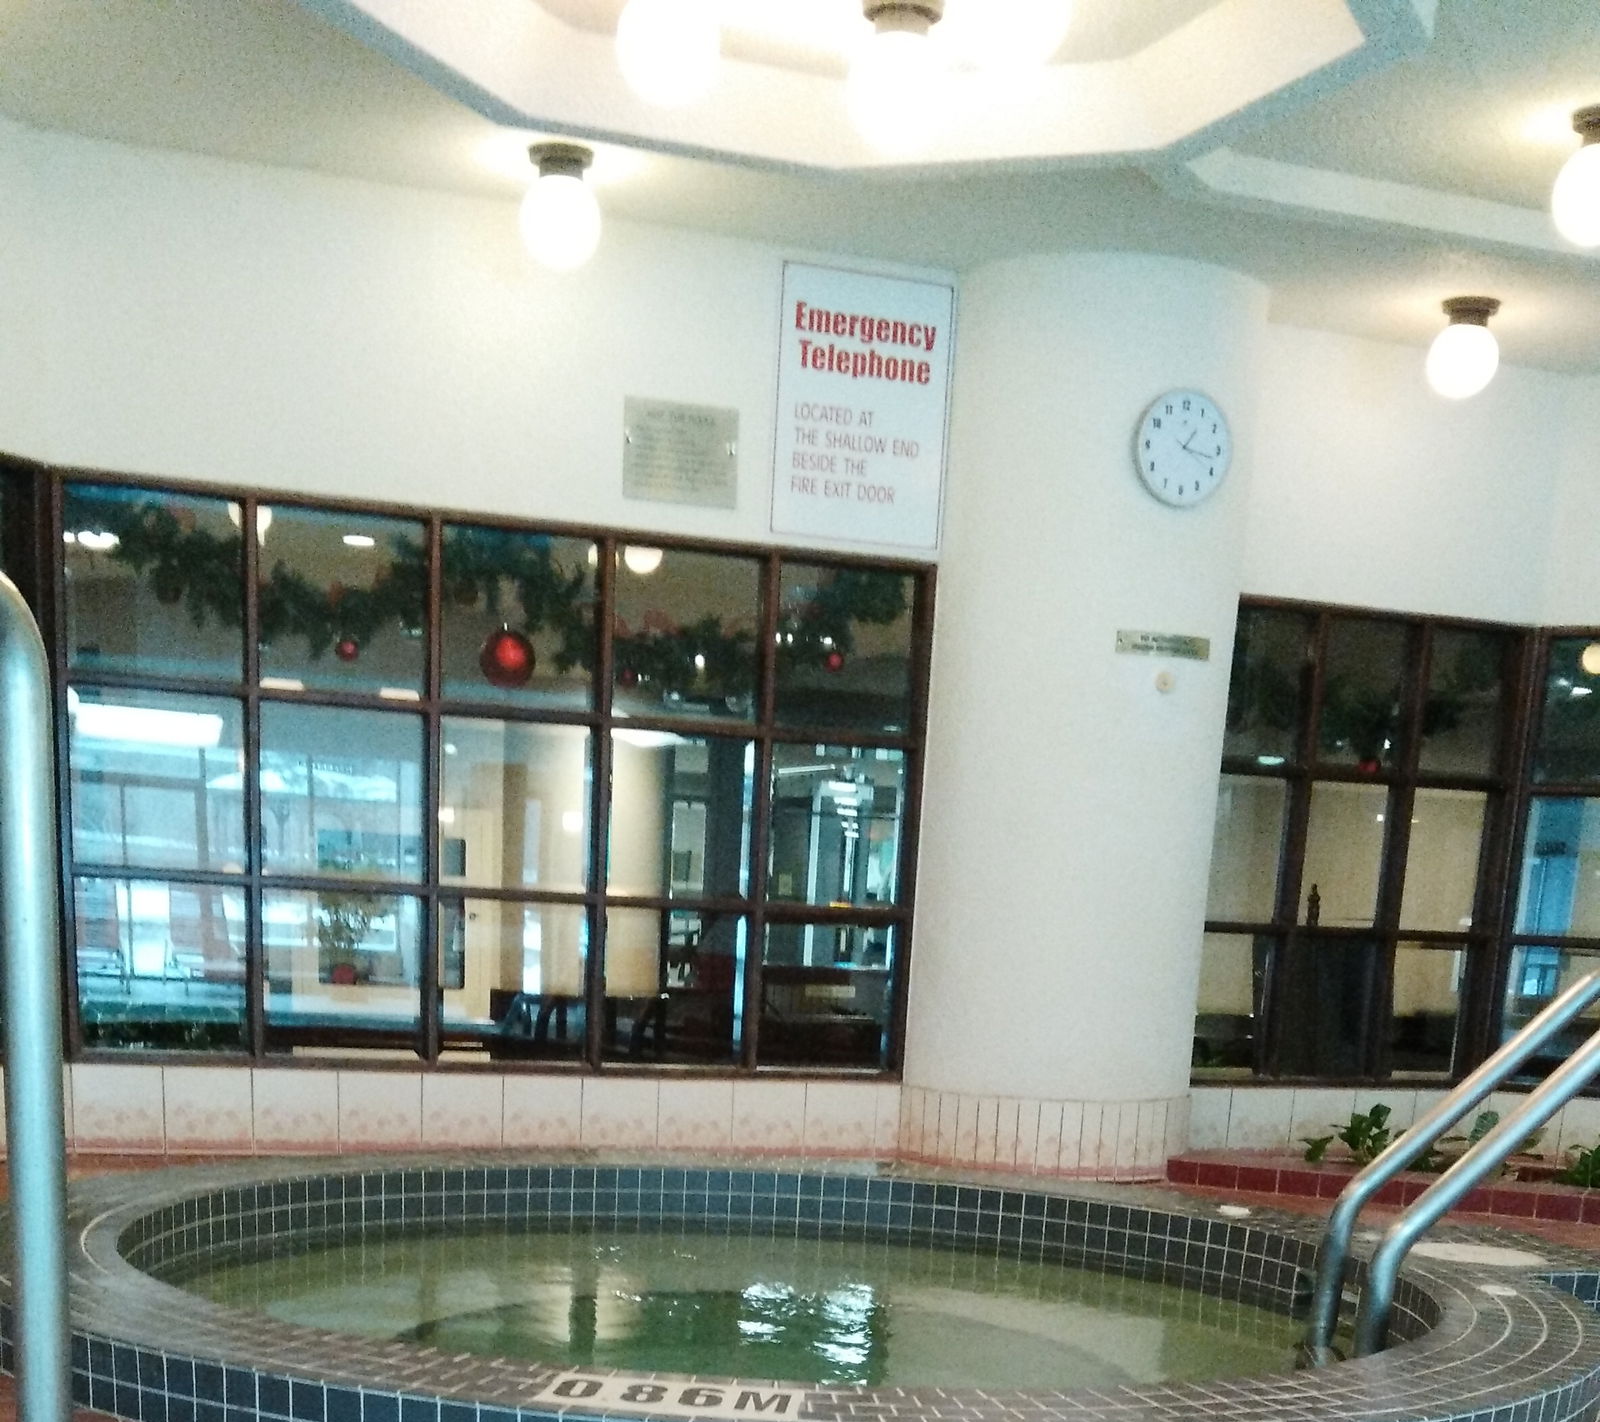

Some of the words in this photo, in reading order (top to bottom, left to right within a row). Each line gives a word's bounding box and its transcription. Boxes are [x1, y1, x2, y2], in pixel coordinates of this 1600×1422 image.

[795, 300, 937, 351] Emergency
[799, 338, 931, 385] Telephone
[794, 402, 853, 425] LOCATED
[860, 410, 875, 427] AT
[795, 426, 819, 446] THE
[825, 430, 887, 454] SHALLOW
[892, 439, 919, 459] END
[792, 451, 837, 473] BESIDE
[844, 457, 867, 477] THE
[790, 475, 817, 495] FIRE
[824, 479, 851, 499] EXIT
[857, 483, 896, 504] DOOR
